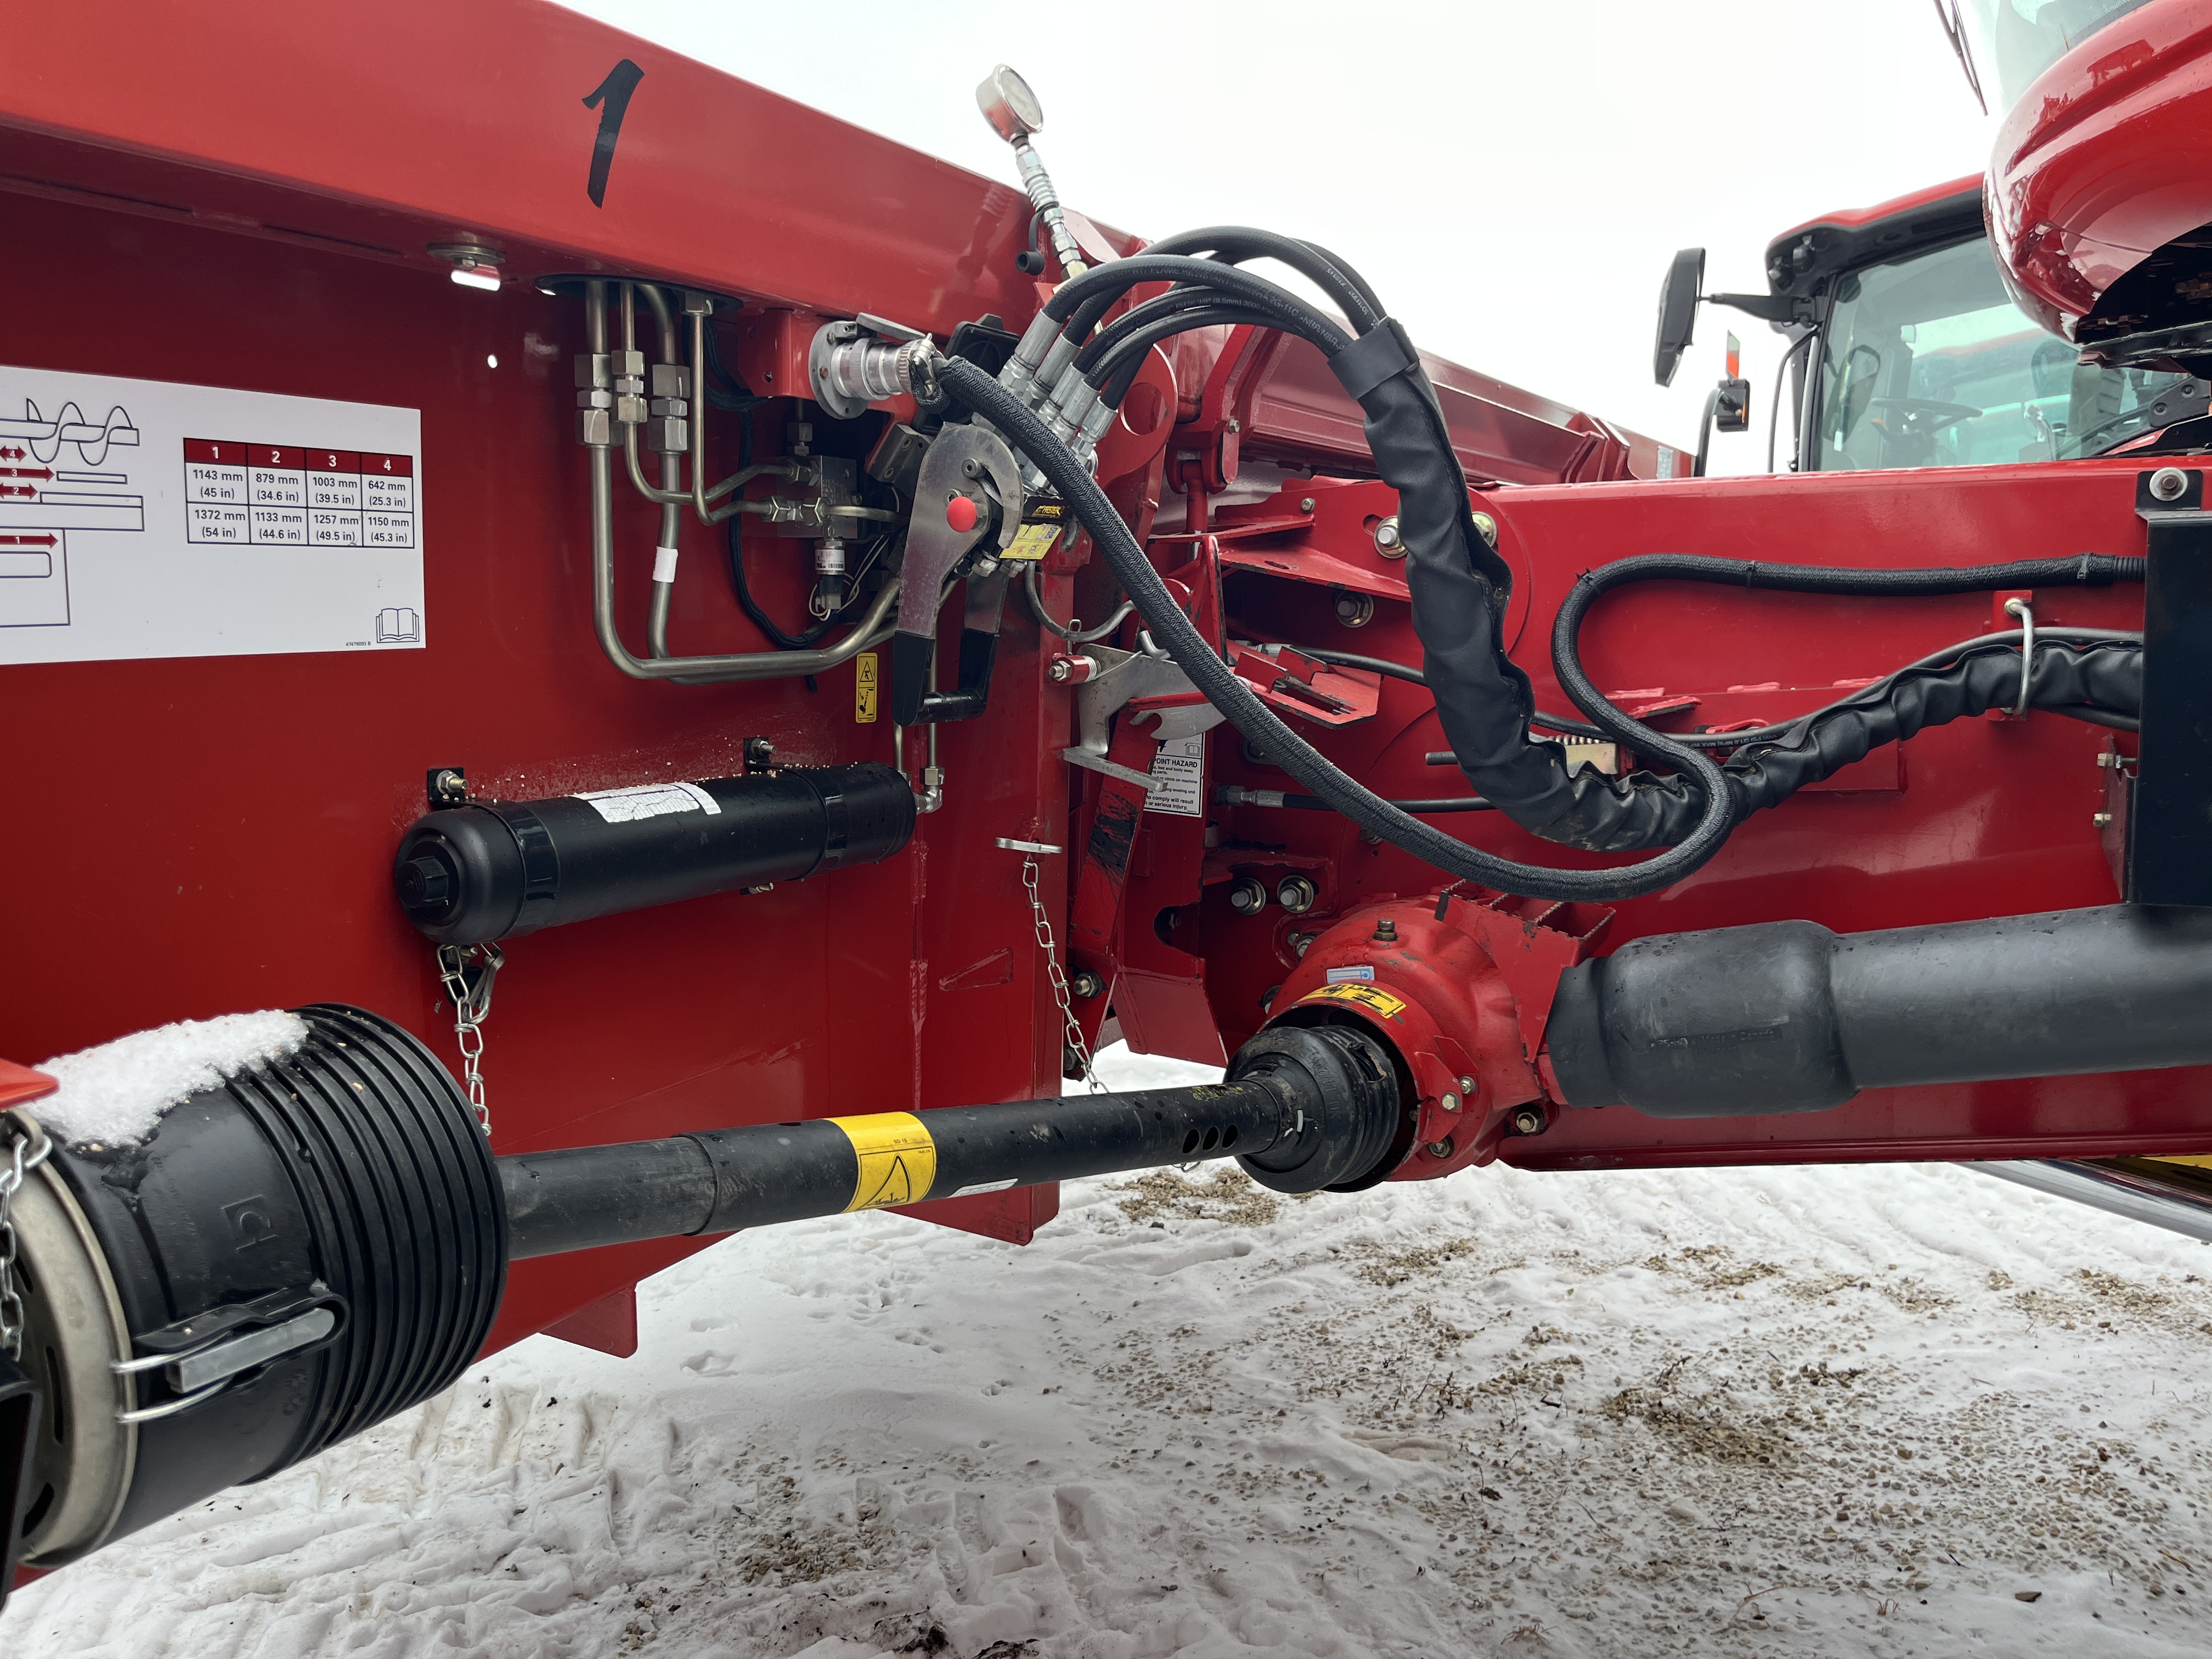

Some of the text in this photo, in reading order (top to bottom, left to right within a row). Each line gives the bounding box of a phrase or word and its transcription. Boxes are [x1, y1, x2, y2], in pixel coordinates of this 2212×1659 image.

[582, 59, 645, 209] 1
[10, 450, 15, 458] 4
[212, 447, 391, 471] 1 2 3 4
[12, 469, 18, 477] 3
[193, 470, 242, 482] 1143 mm
[256, 473, 298, 485] 879 mm
[313, 477, 358, 488] 1003 mm
[13, 487, 19, 495] 2
[369, 481, 406, 491] 642 mm
[200, 486, 235, 499] (45 in)
[257, 489, 299, 503] (34.6 in)
[316, 493, 354, 505] (39.5 in)
[369, 496, 406, 508] (25.3 in)
[195, 510, 246, 521] 1372 mm
[256, 512, 302, 523] 1133 mm
[314, 515, 359, 525] 1257 mm
[368, 517, 388, 526] 1150
[202, 527, 236, 539] (54 in)
[259, 528, 301, 541] (44.6 in)
[317, 530, 355, 542] (49.5 in)
[371, 532, 407, 543] (45.3 in)
[15, 536, 20, 544] 1
[1172, 759, 1197, 768] HAZARD
